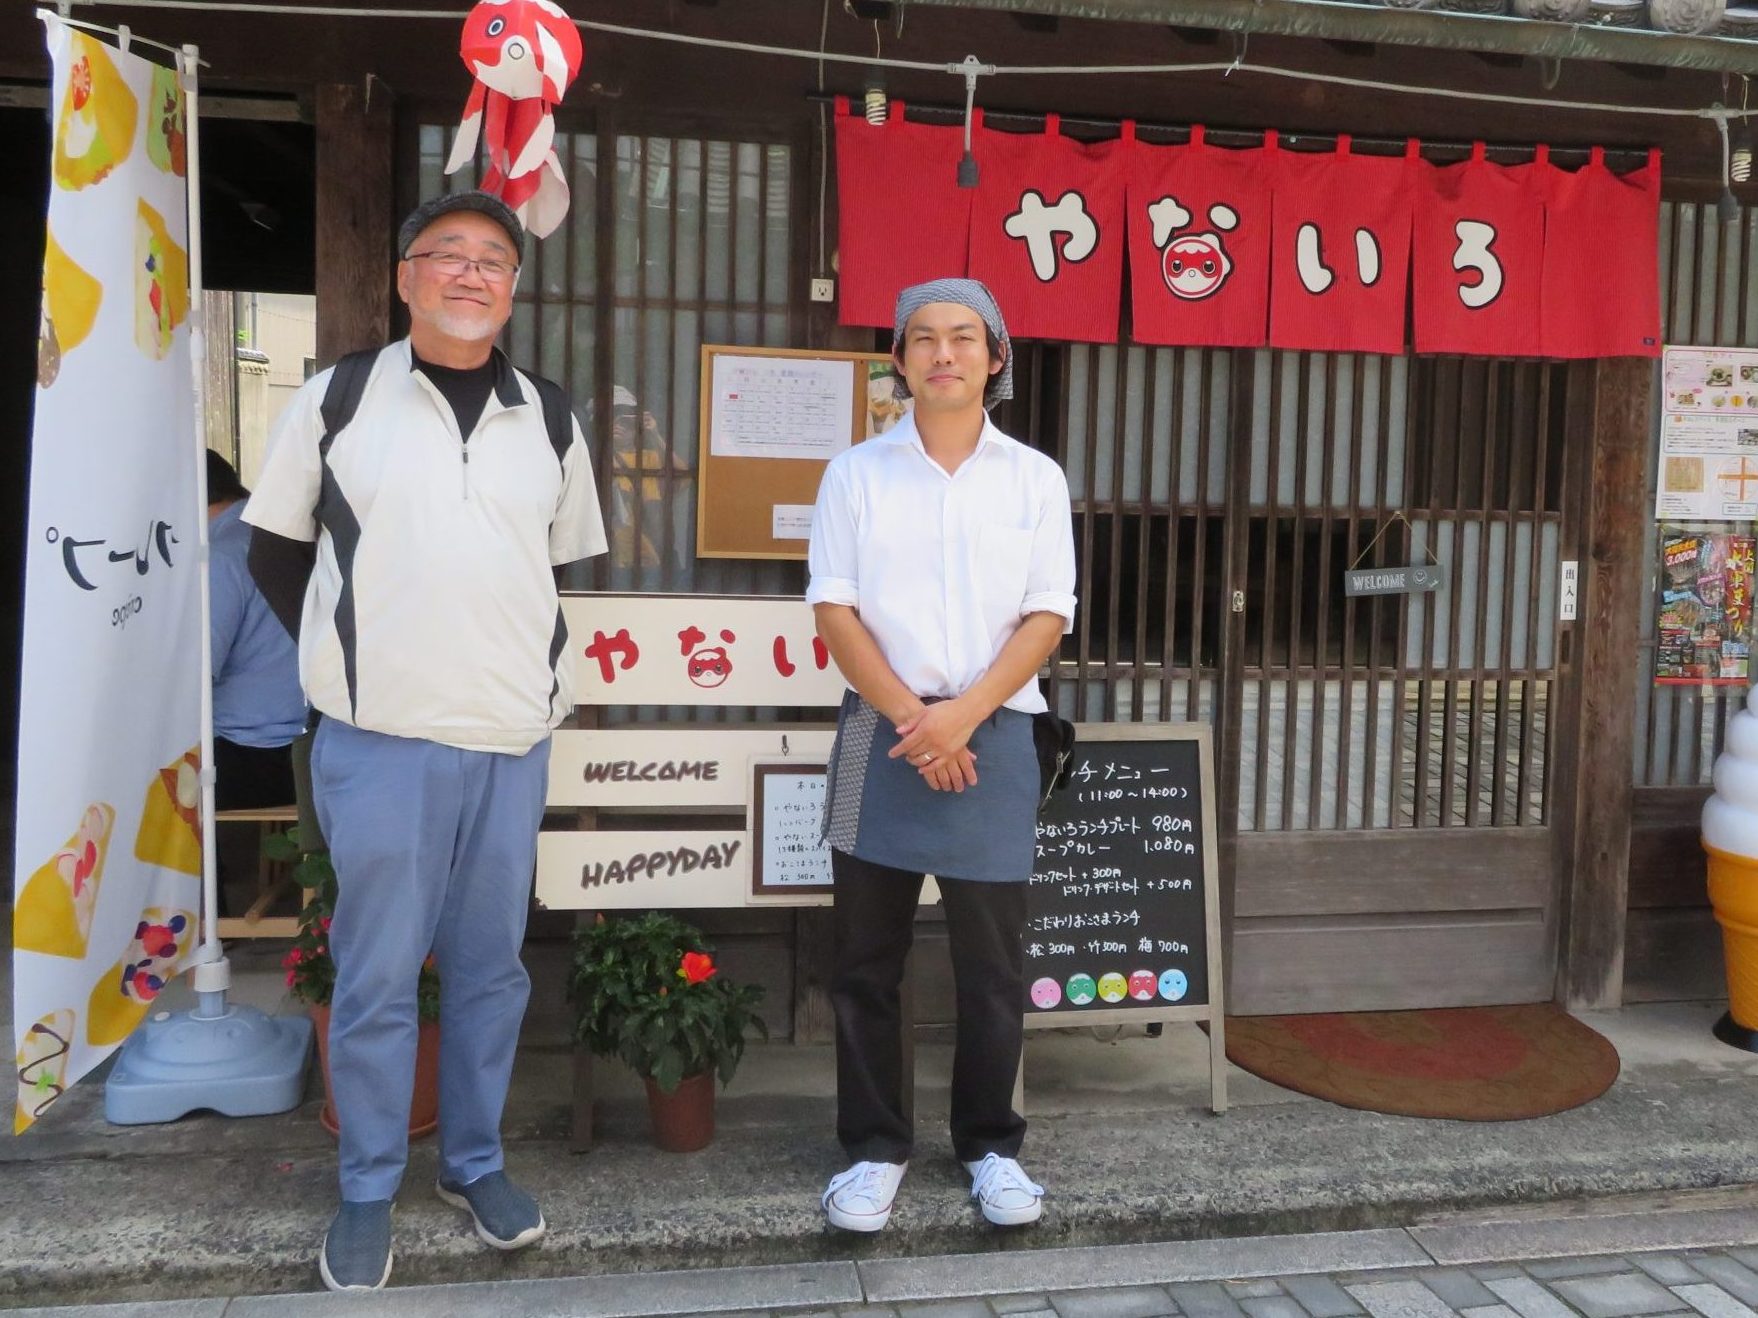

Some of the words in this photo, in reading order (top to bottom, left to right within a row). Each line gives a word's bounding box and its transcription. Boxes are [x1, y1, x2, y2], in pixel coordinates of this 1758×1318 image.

[1003, 188, 1504, 309] やないろ
[1352, 573, 1405, 591] WELCOME
[1564, 568, 1575, 613] 出入口
[583, 761, 719, 784] WELCOME
[1071, 760, 1170, 782] チメニュー
[1035, 816, 1141, 839] やないろランチプレート
[1152, 815, 1192, 832] 980円
[1036, 840, 1111, 858] スープカレー
[1158, 940, 1189, 954] 700円
